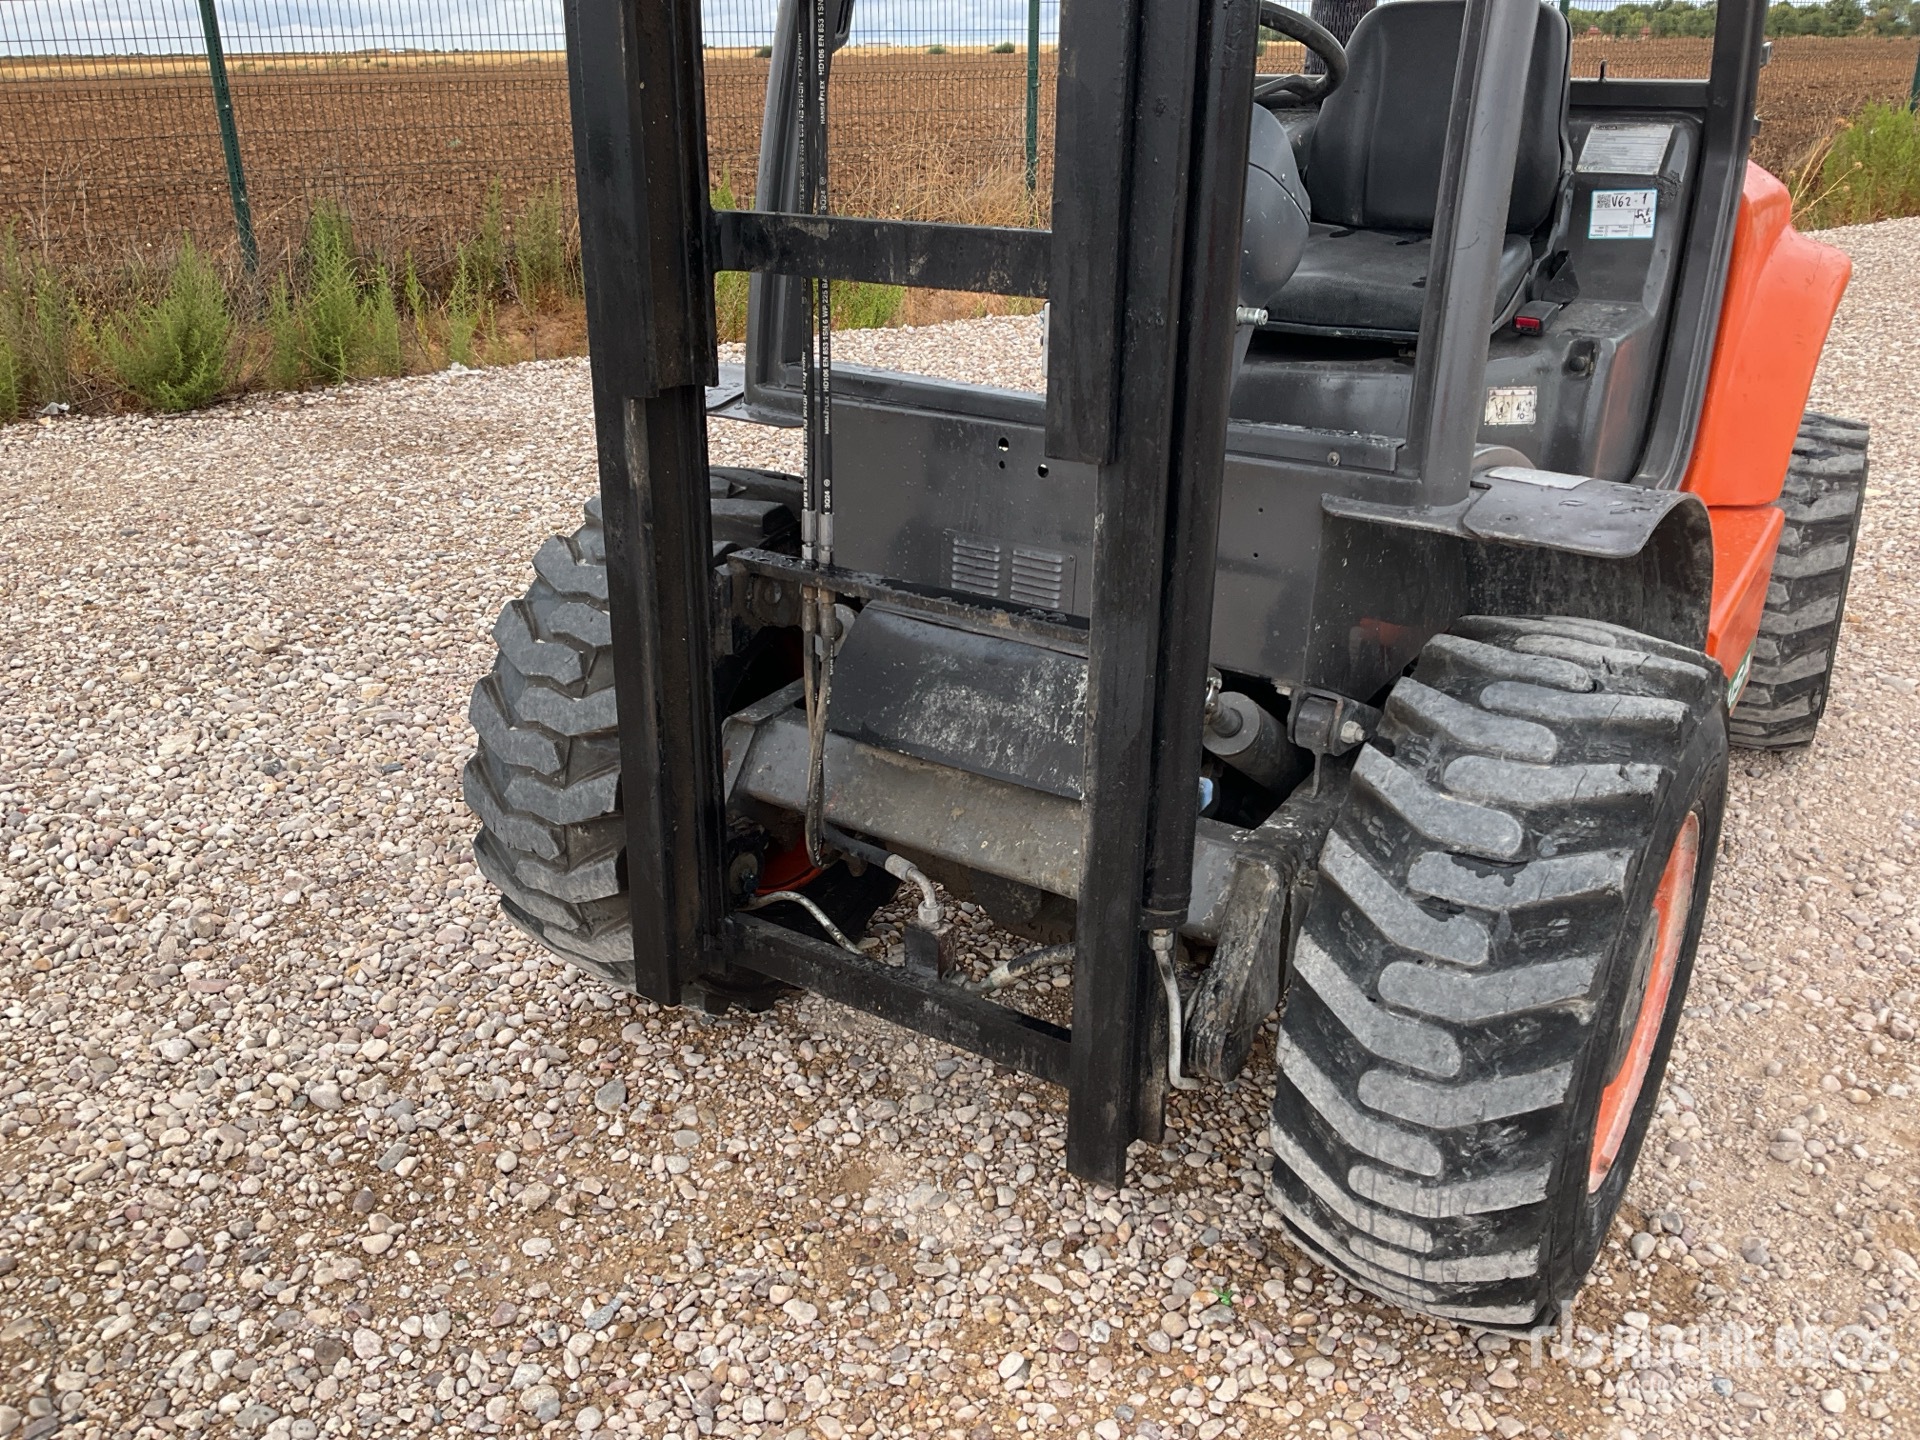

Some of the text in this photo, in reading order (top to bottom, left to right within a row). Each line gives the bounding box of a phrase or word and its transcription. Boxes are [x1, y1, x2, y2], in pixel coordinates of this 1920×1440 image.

[818, 34, 825, 47] EN
[822, 306, 828, 318] WP
[823, 356, 829, 367] EN
